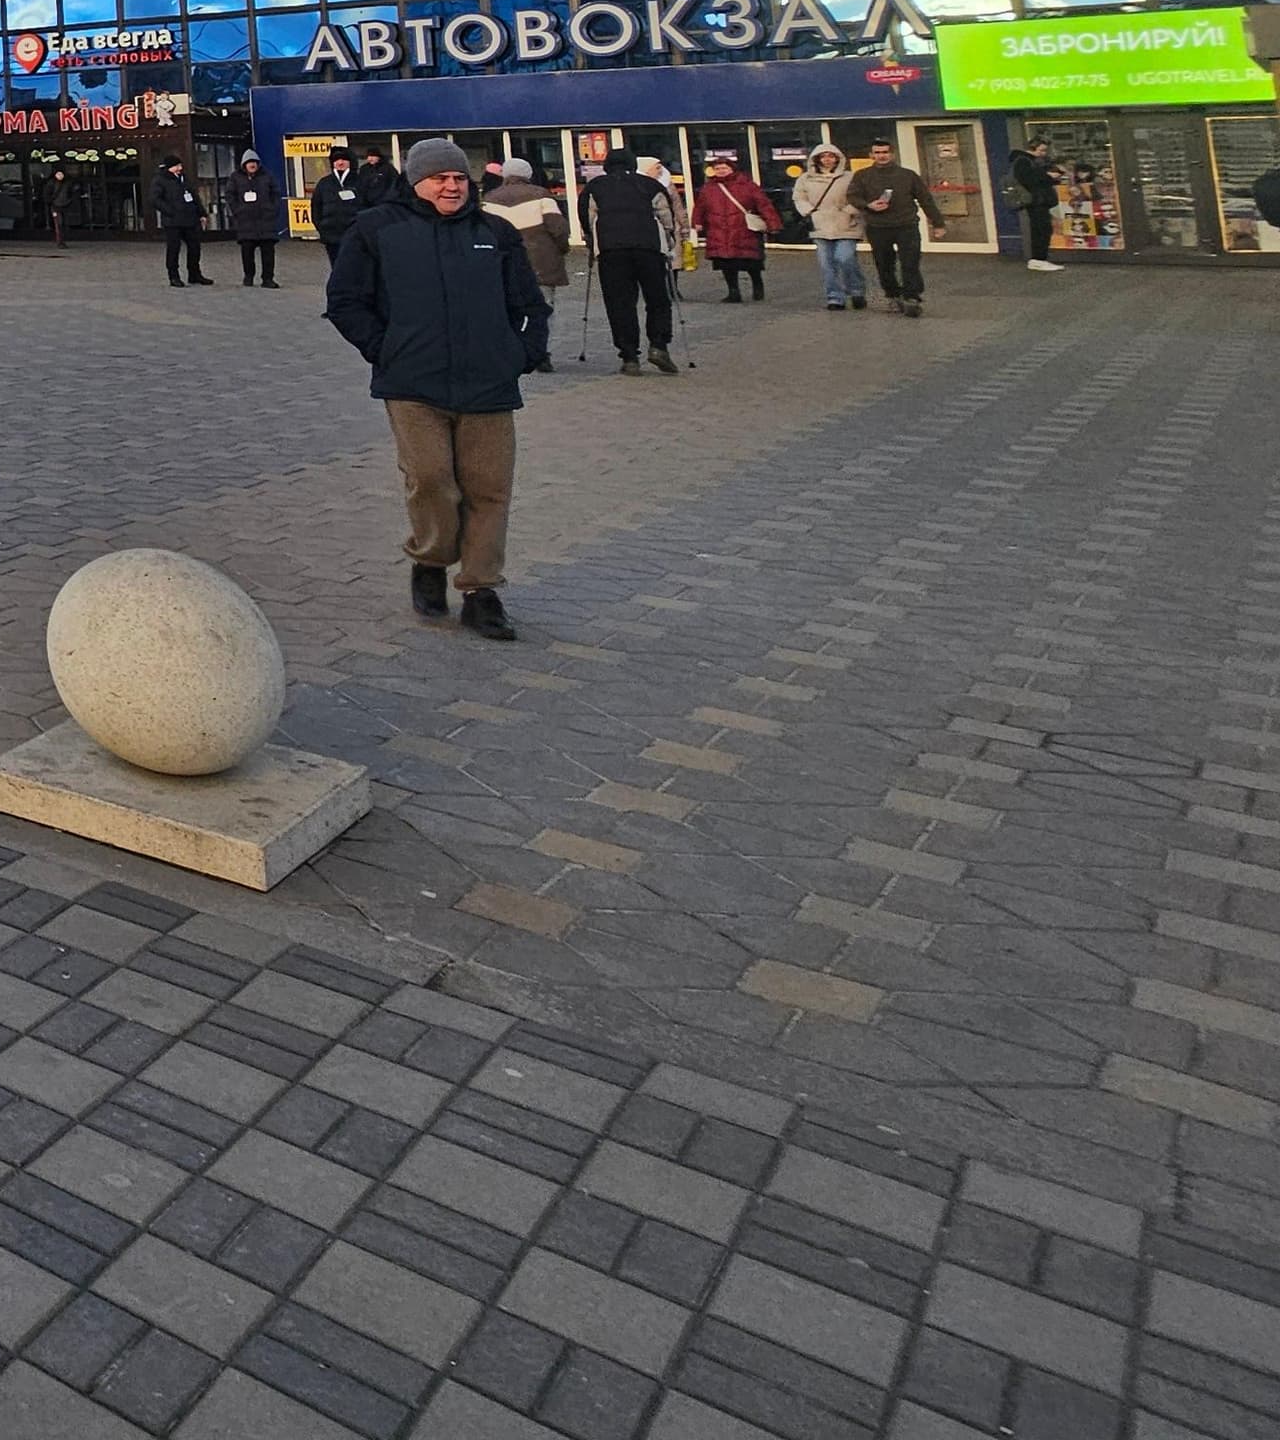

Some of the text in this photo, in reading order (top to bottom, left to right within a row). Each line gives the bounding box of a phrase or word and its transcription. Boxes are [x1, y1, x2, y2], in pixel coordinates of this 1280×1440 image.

[47, 31, 89, 55] Еда
[93, 28, 173, 50] всегда
[1000, 20, 1227, 59] ЗАБРОНИРУЙ!
[89, 50, 173, 65] столовых
[968, 78, 986, 91] +7
[990, 76, 1027, 94] (903)
[1031, 73, 1110, 90] 402-77-75
